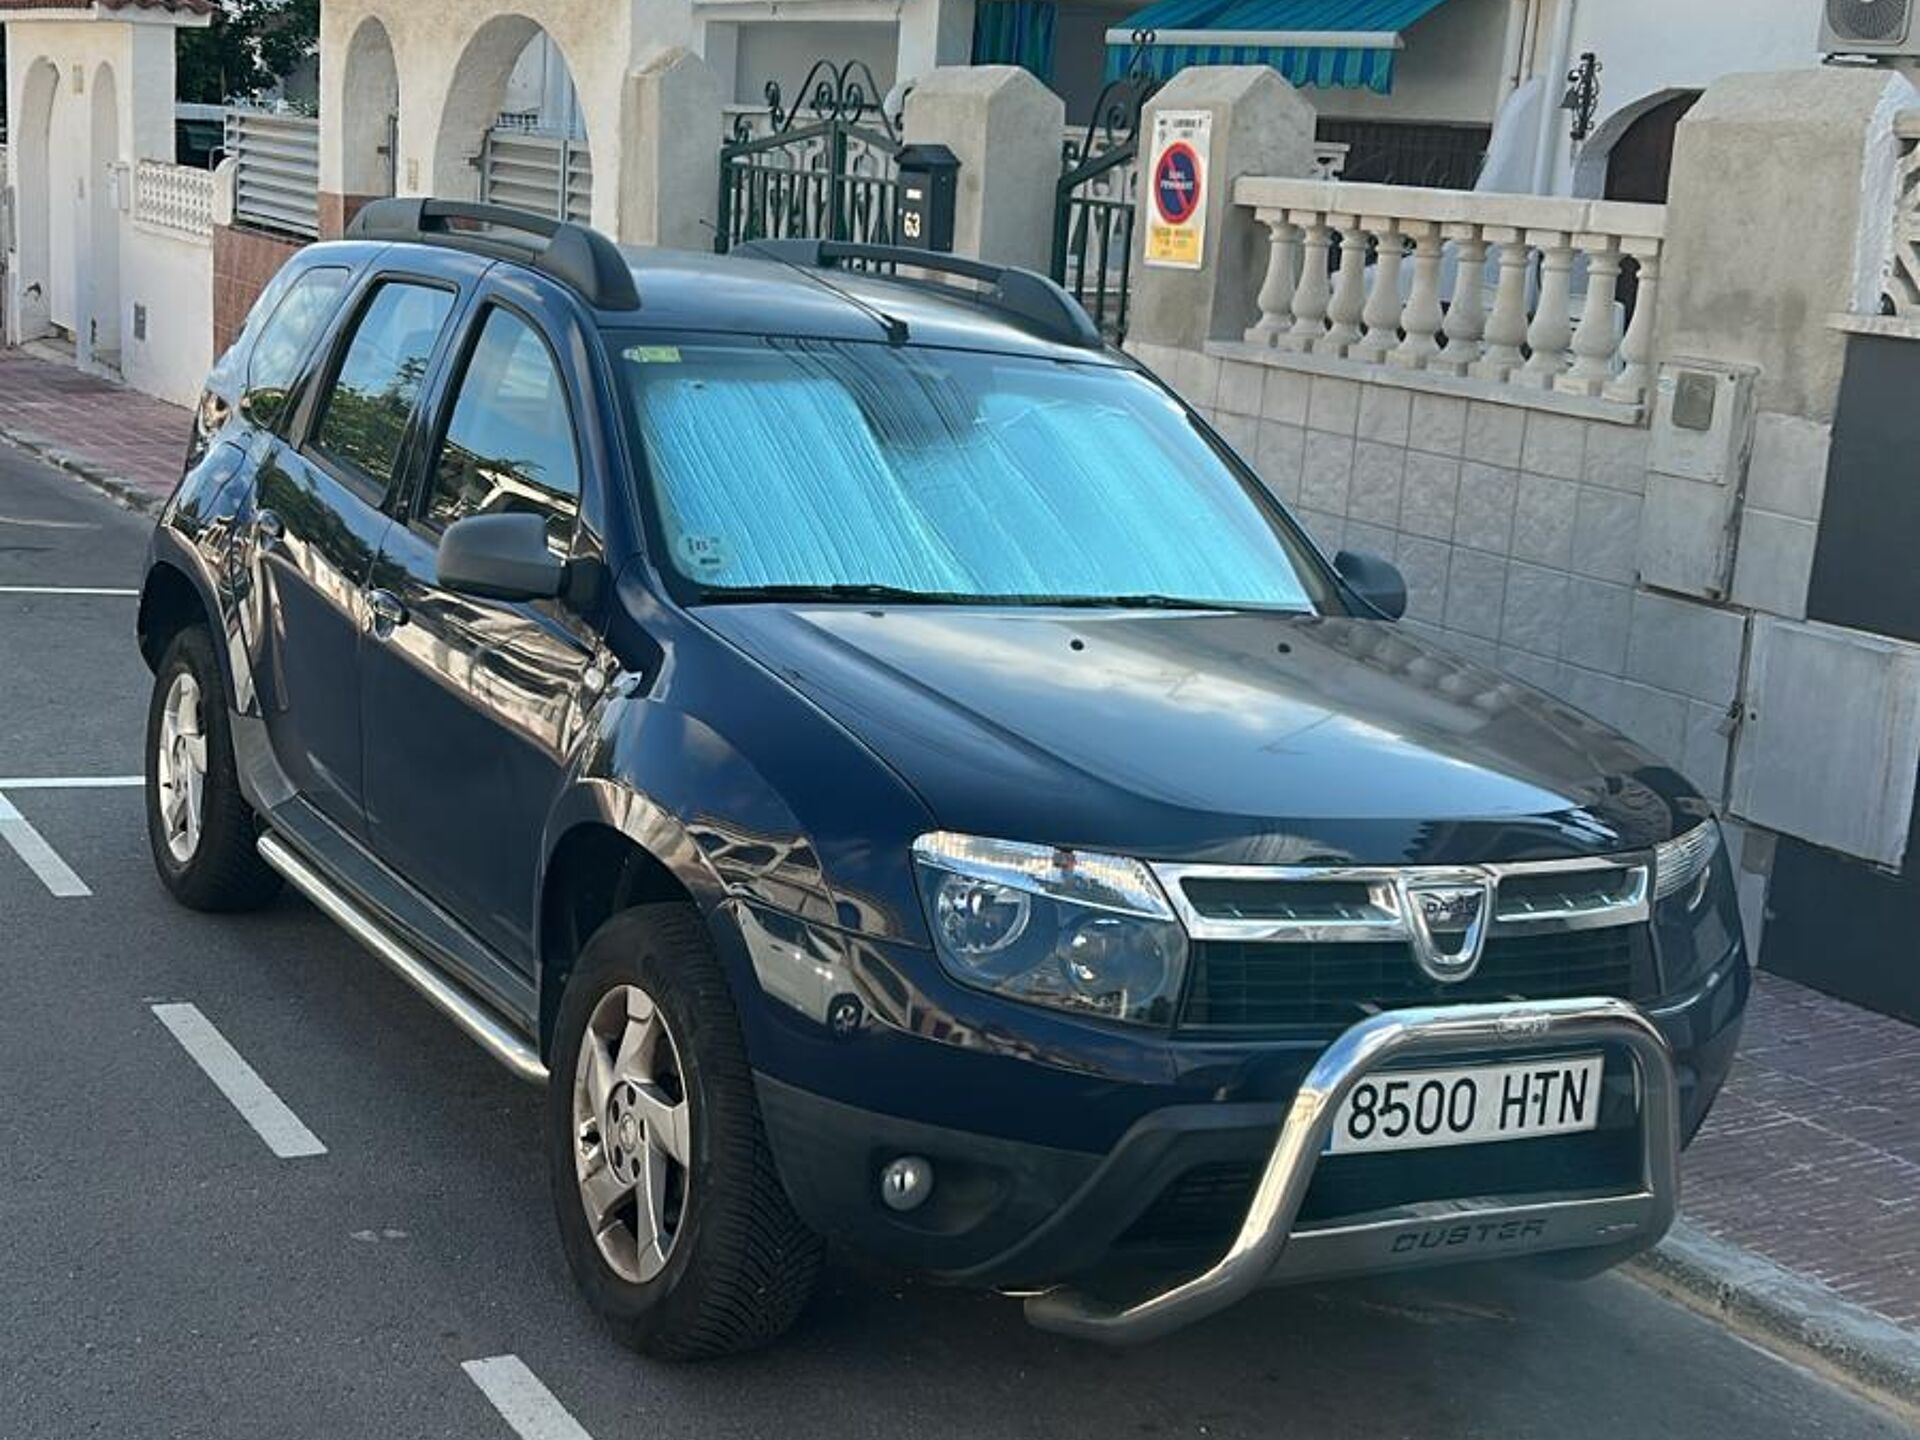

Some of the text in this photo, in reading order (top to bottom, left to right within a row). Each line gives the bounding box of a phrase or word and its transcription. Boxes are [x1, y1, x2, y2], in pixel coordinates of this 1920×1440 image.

[904, 212, 921, 239] 63
[1348, 1068, 1588, 1140] 8500 HTN
[1393, 1219, 1548, 1252] DUSTER
